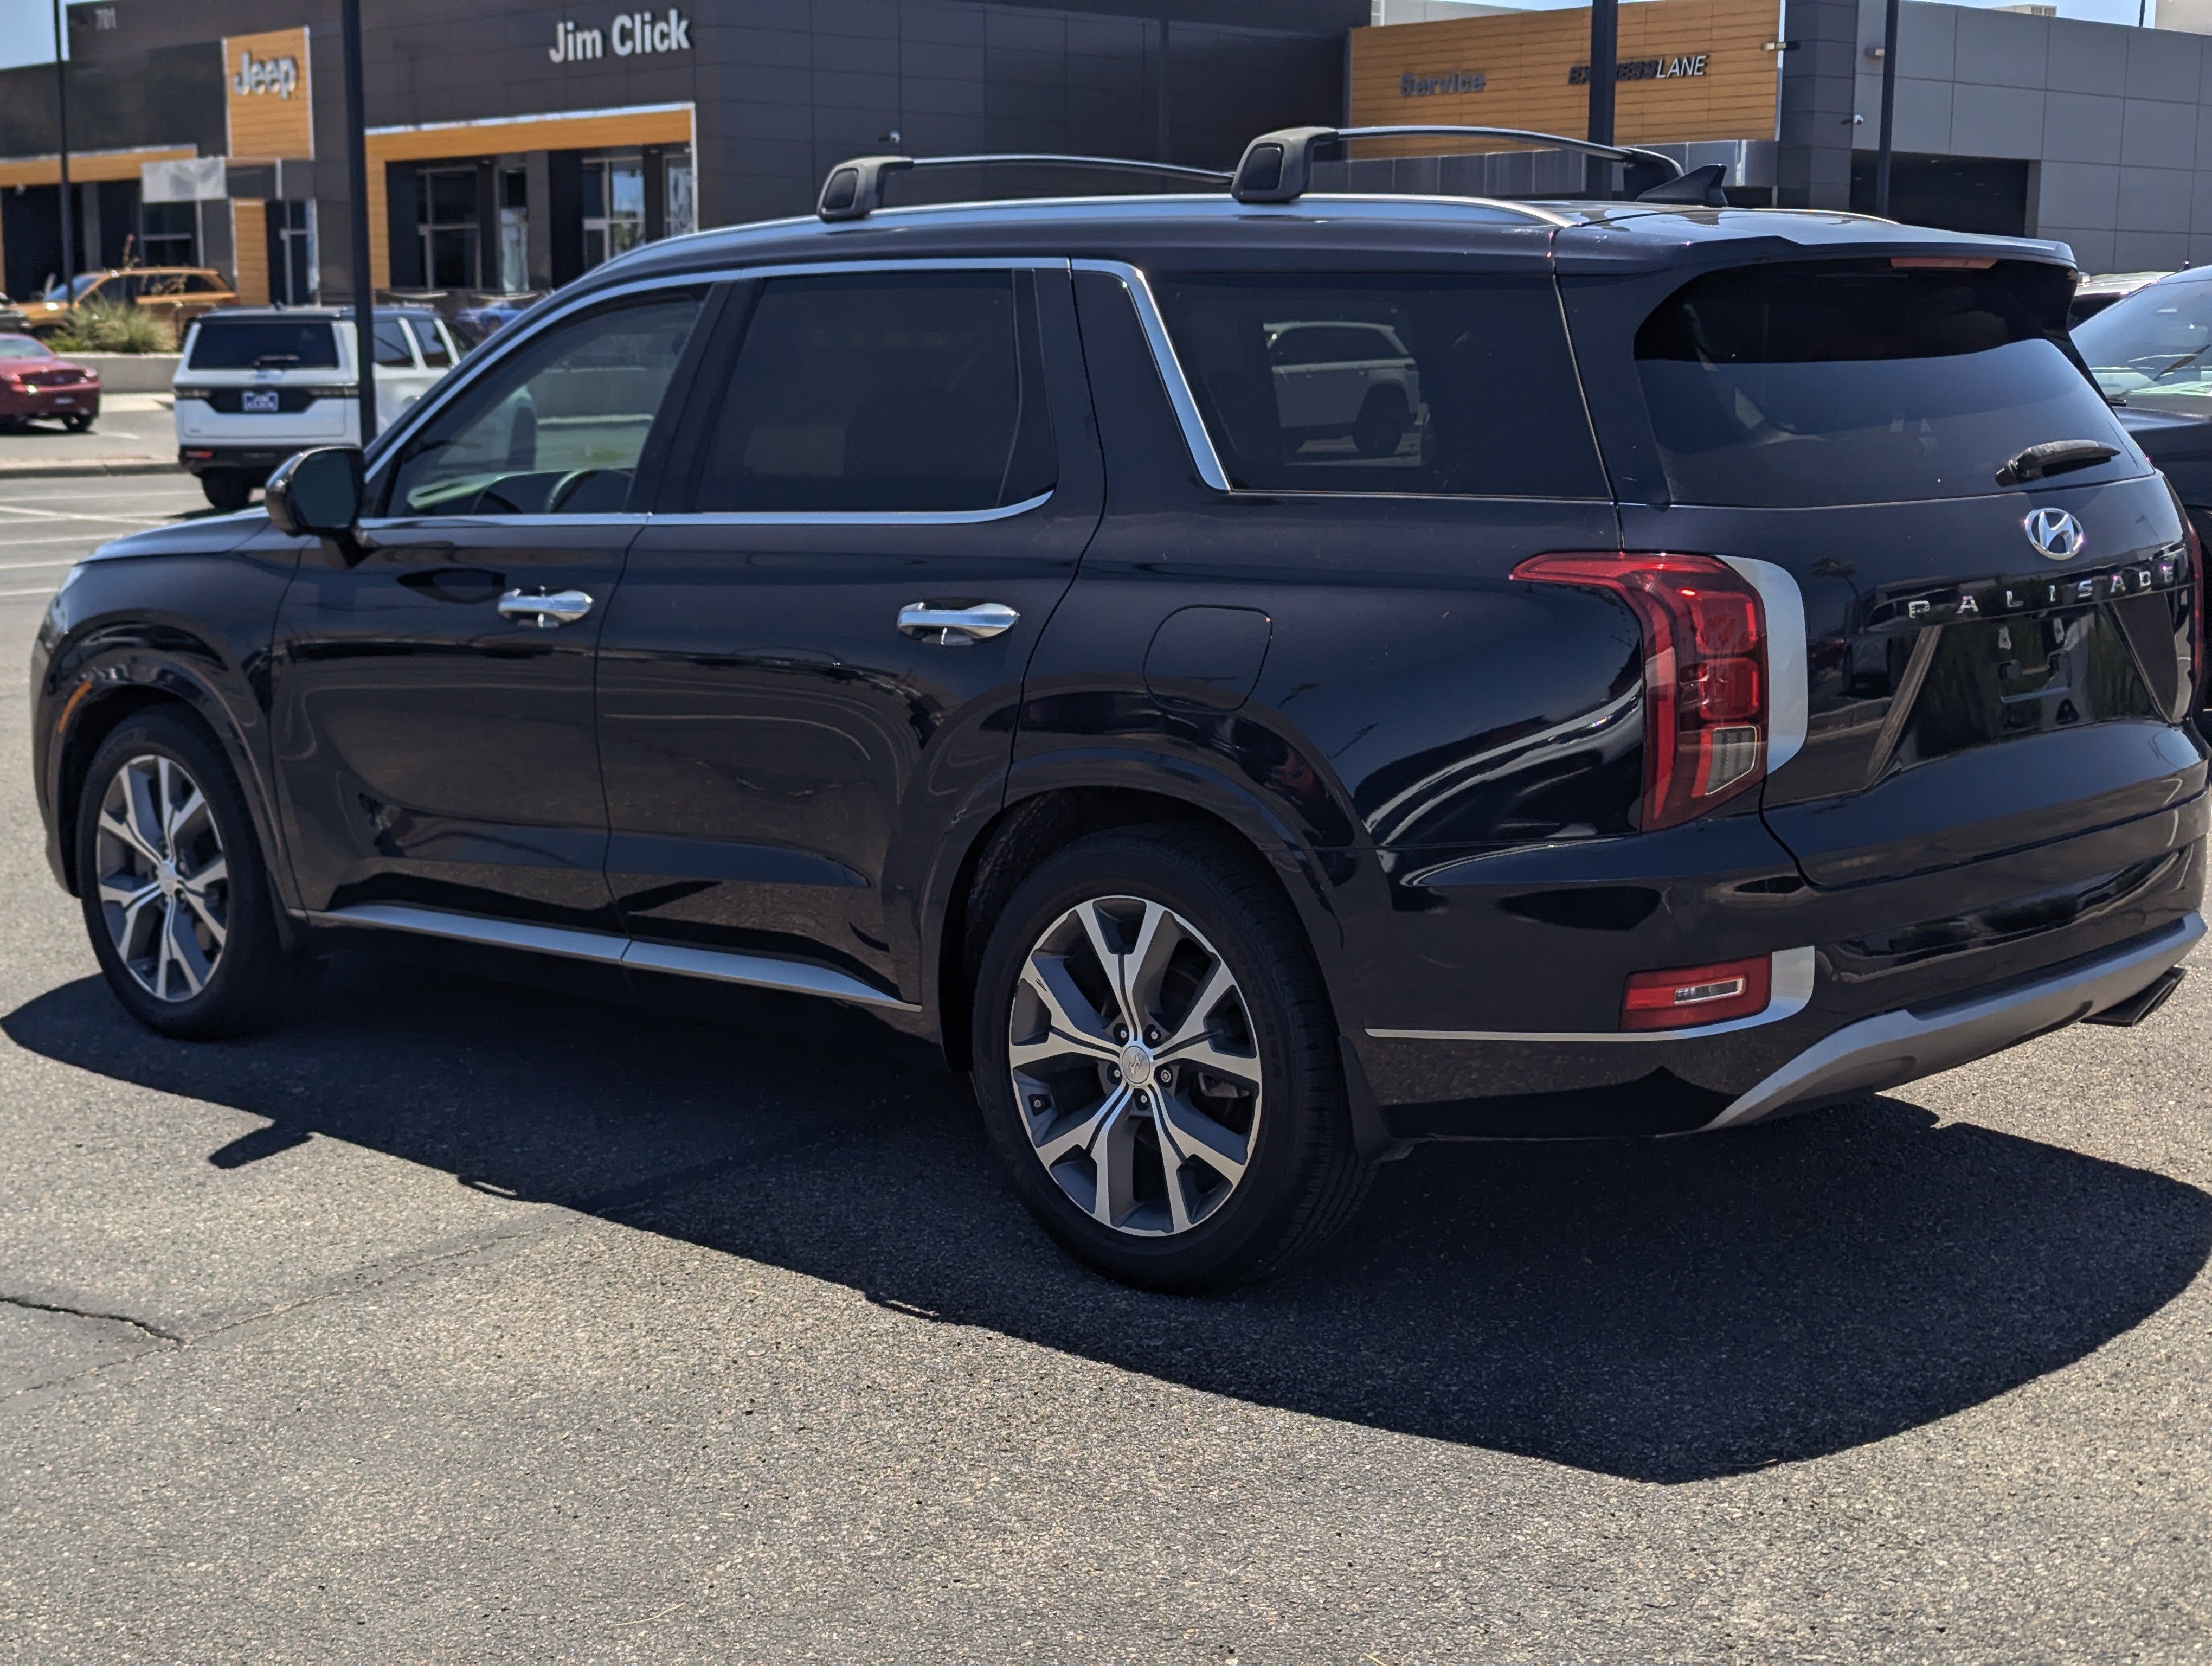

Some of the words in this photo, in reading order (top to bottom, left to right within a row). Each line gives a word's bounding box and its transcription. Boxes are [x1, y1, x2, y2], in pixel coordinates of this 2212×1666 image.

[548, 21, 604, 63] Jim
[611, 8, 691, 56] Click
[232, 51, 298, 100] Jeep
[1400, 70, 1487, 97] Service
[1907, 567, 2174, 619] PALISADE
